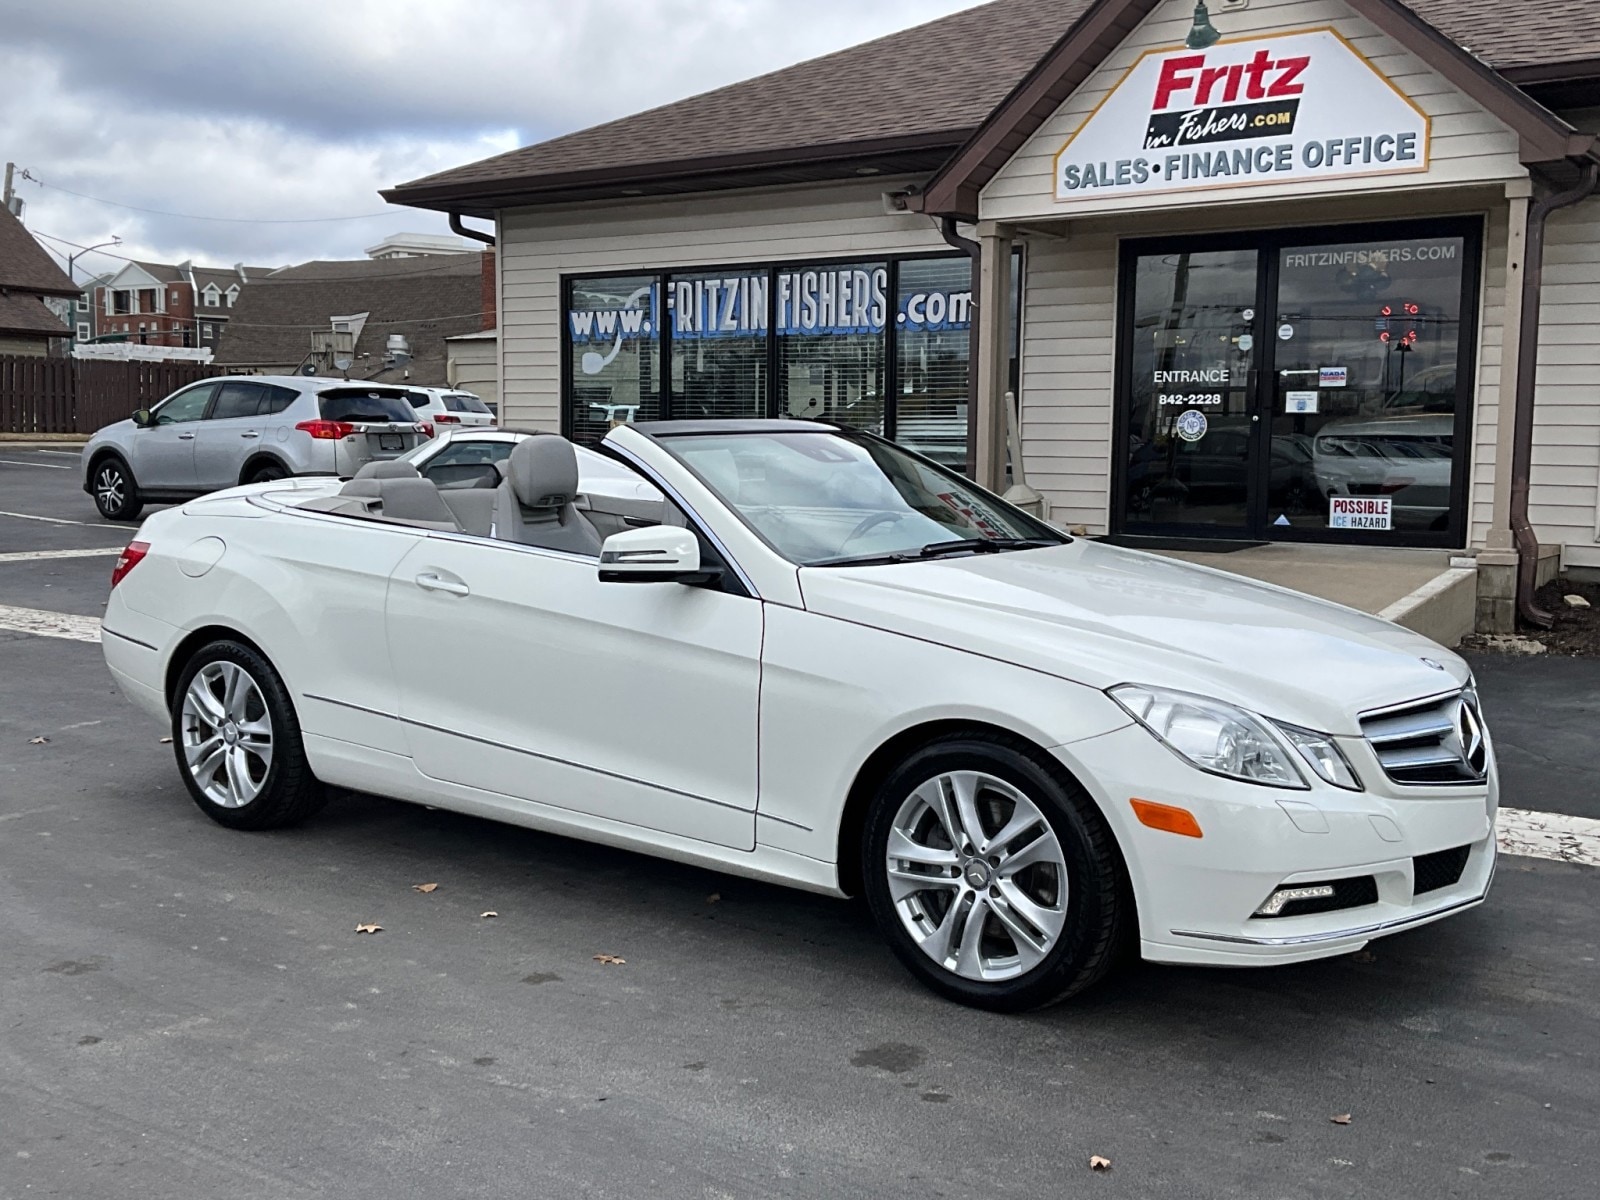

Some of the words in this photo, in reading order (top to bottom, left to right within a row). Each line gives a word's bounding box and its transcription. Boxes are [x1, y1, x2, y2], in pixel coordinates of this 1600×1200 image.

[1152, 50, 1311, 110] Fritz
[1147, 127, 1171, 149] in
[1064, 158, 1149, 190] SALES
[1164, 143, 1293, 181] FINANCE
[1302, 132, 1416, 169] OFFICE
[1286, 245, 1456, 268] FRITZINFISHERS.COM
[1153, 369, 1230, 383] ENTRANCE
[1159, 393, 1221, 405] 842-2228
[1333, 499, 1389, 515] POSSIBLE
[1332, 515, 1347, 527] ICE
[1350, 516, 1387, 529] HAZARD
